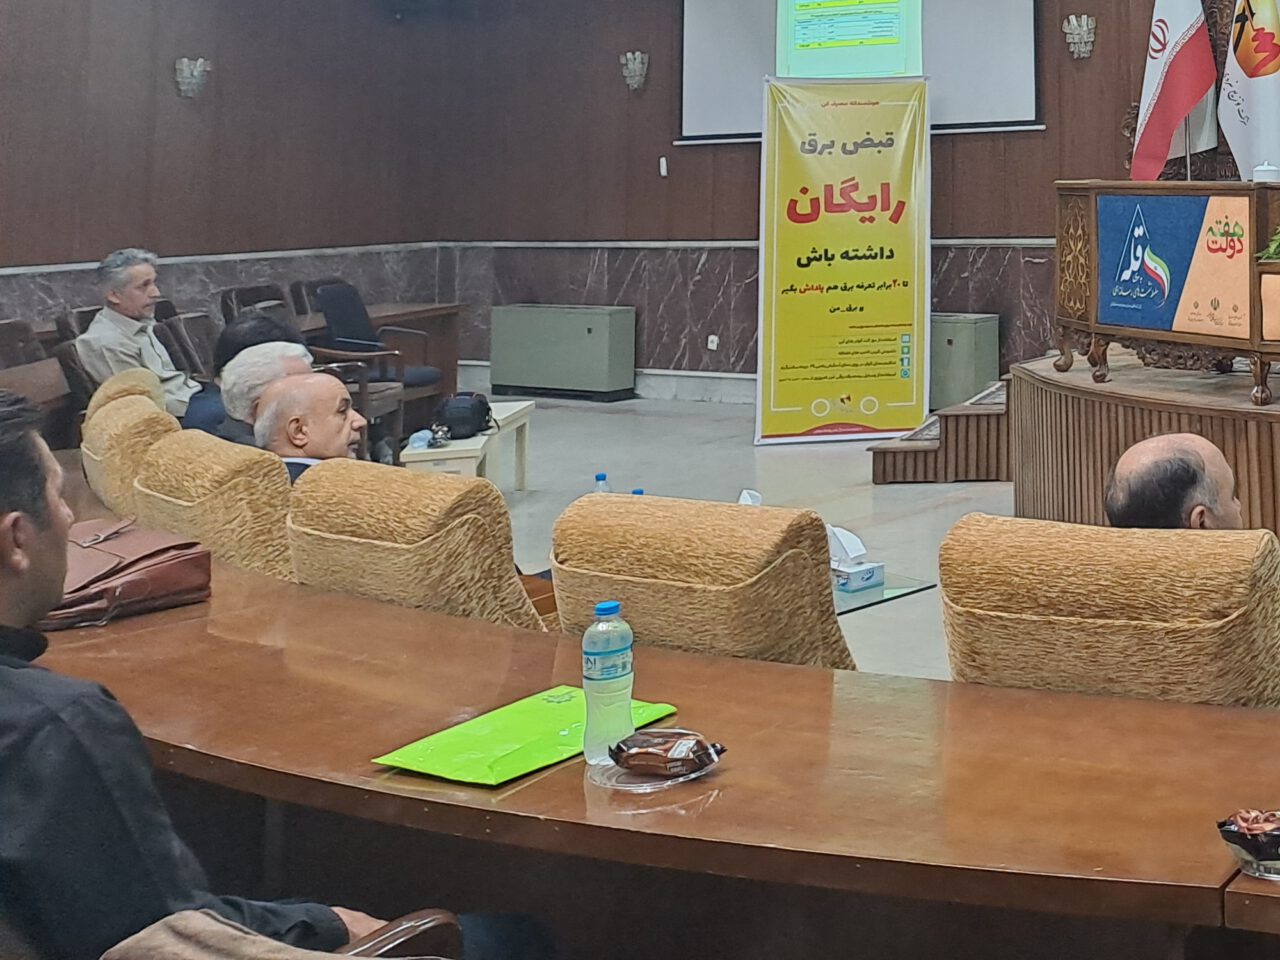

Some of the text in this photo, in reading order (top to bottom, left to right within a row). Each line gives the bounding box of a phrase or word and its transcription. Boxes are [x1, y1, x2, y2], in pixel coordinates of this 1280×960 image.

[800, 131, 895, 155] قبض برق
[786, 176, 906, 224] رایگان
[1207, 215, 1245, 239] هفته
[796, 245, 895, 268] داشته باش
[1120, 224, 1145, 282] قله
[1207, 233, 1244, 259] دولت
[781, 284, 798, 296] بگیر
[799, 283, 825, 295] پاداش
[826, 284, 839, 294] هم
[840, 283, 855, 292] برق
